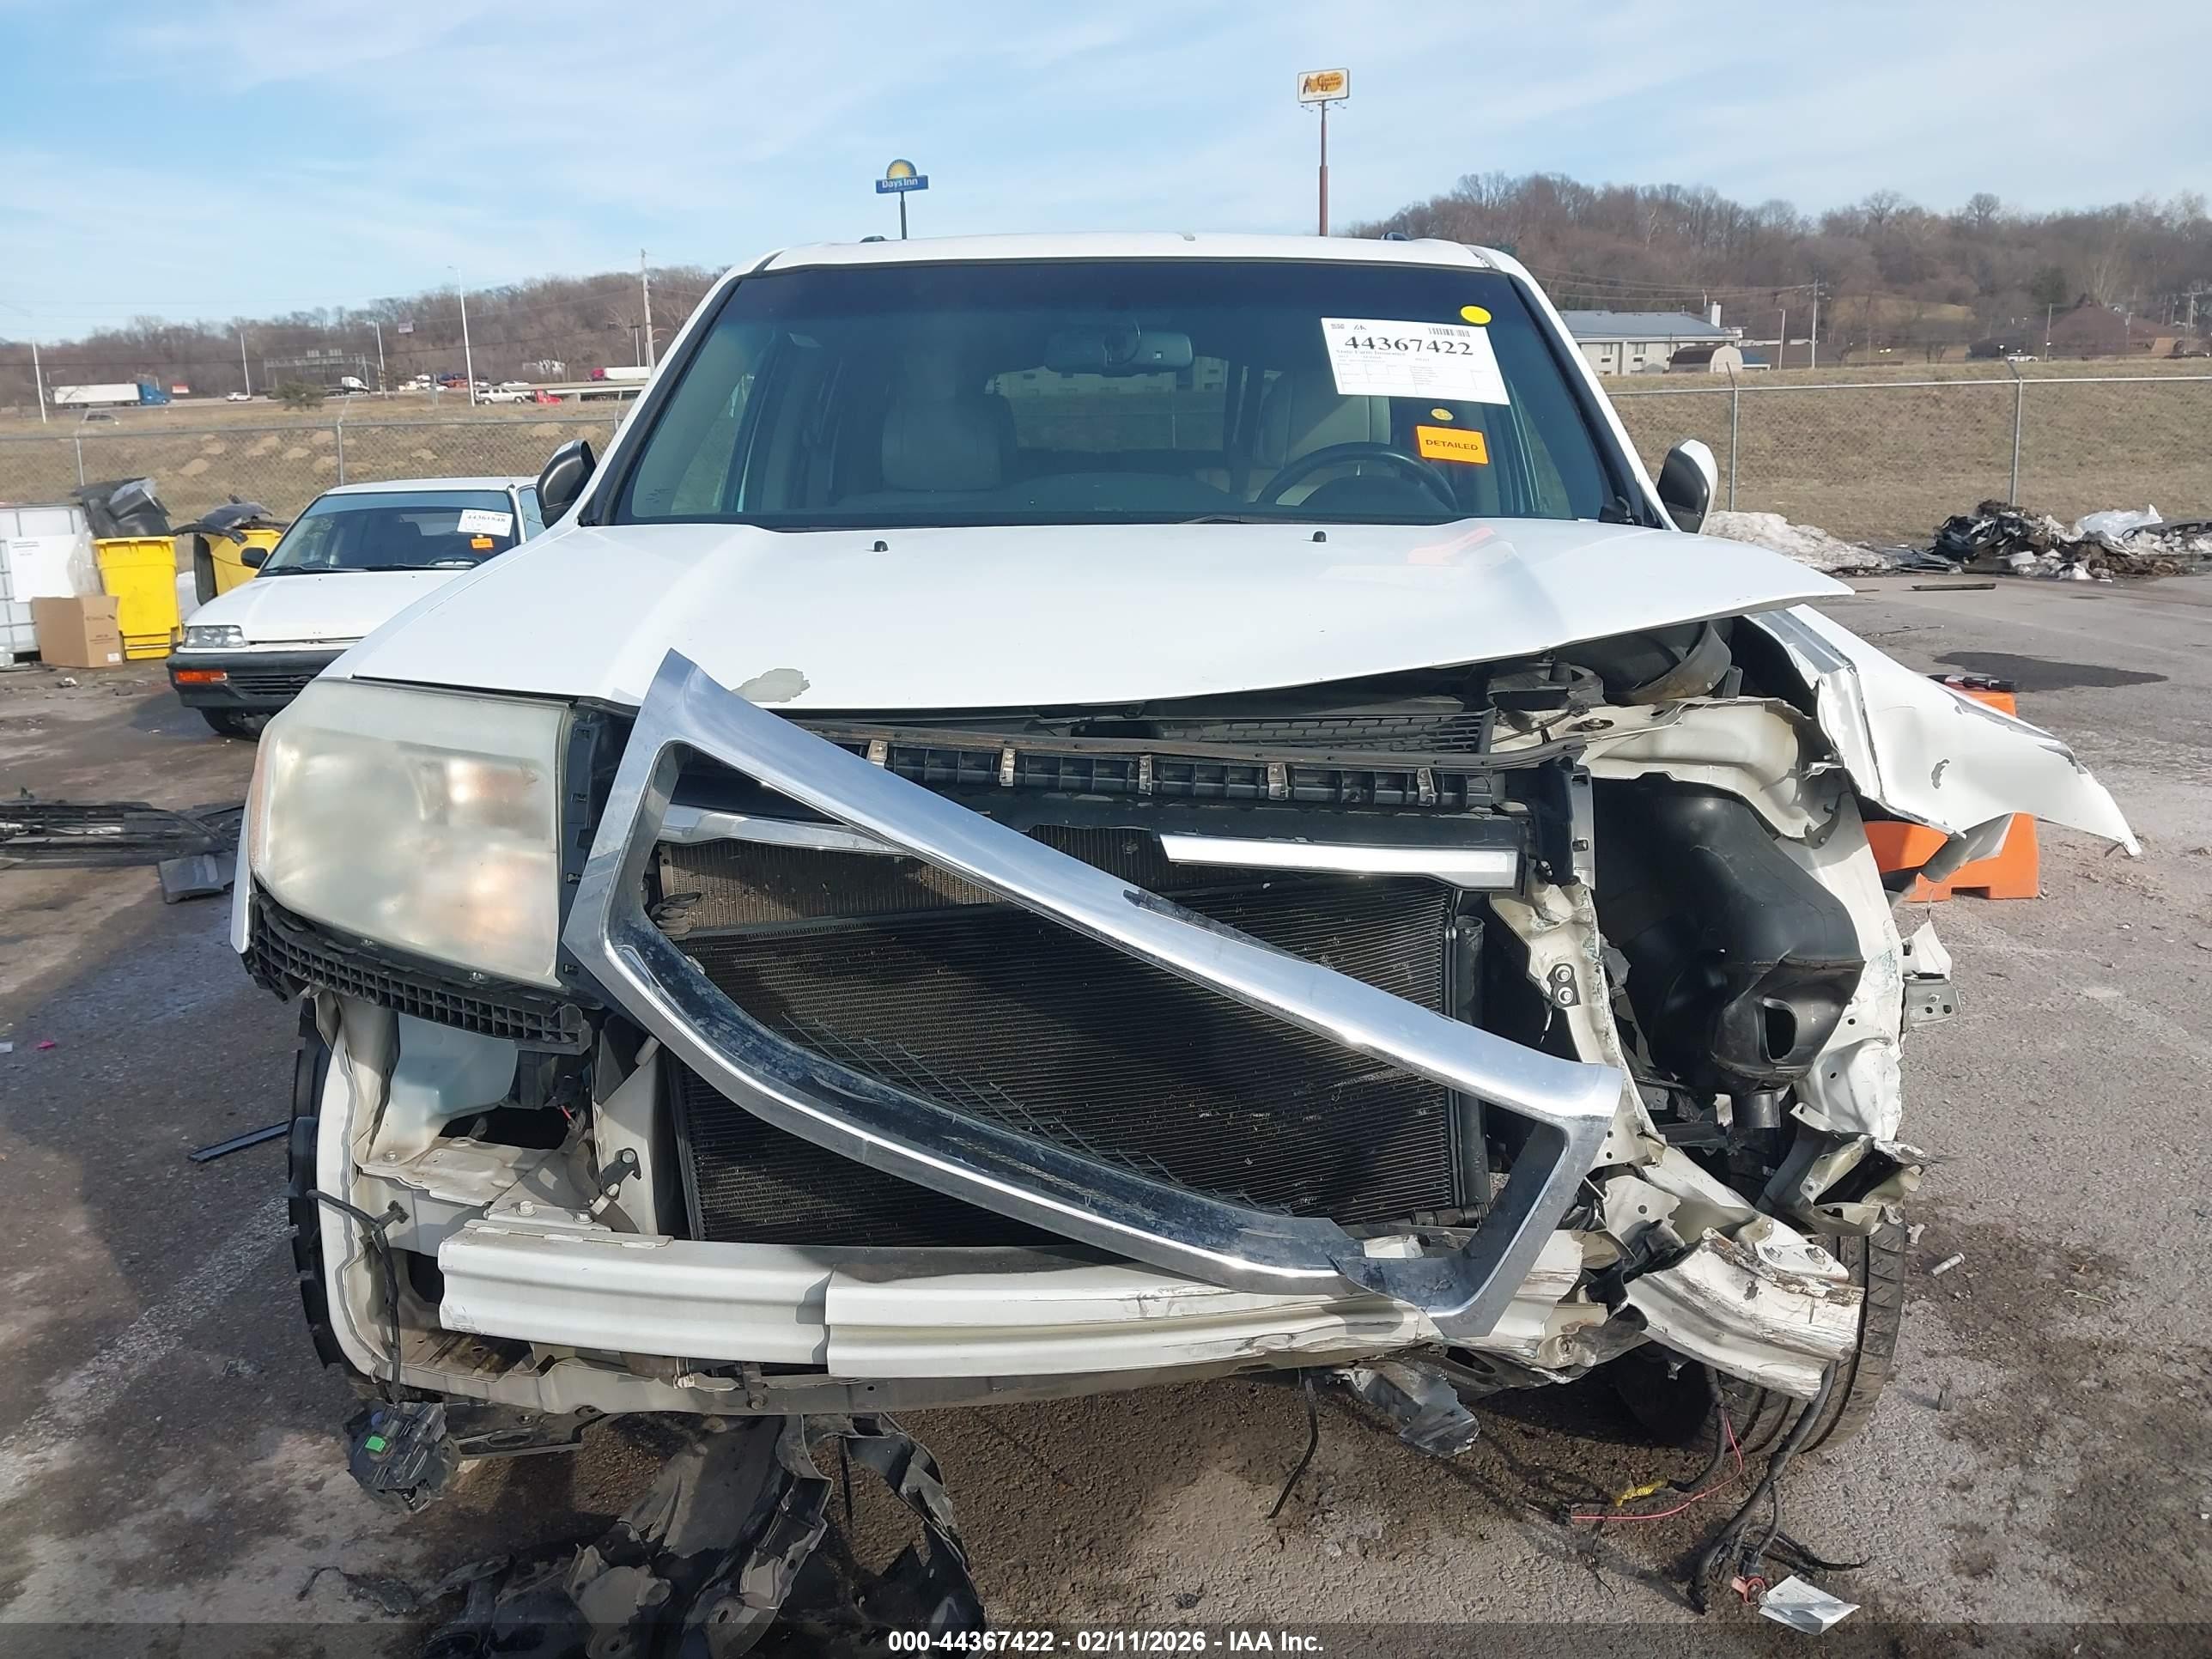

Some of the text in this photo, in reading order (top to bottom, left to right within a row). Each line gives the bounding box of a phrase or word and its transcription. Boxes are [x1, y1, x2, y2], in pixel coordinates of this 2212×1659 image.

[882, 180, 903, 189] Days
[1345, 336, 1474, 356] 44367422
[1425, 439, 1479, 451] DETAILED
